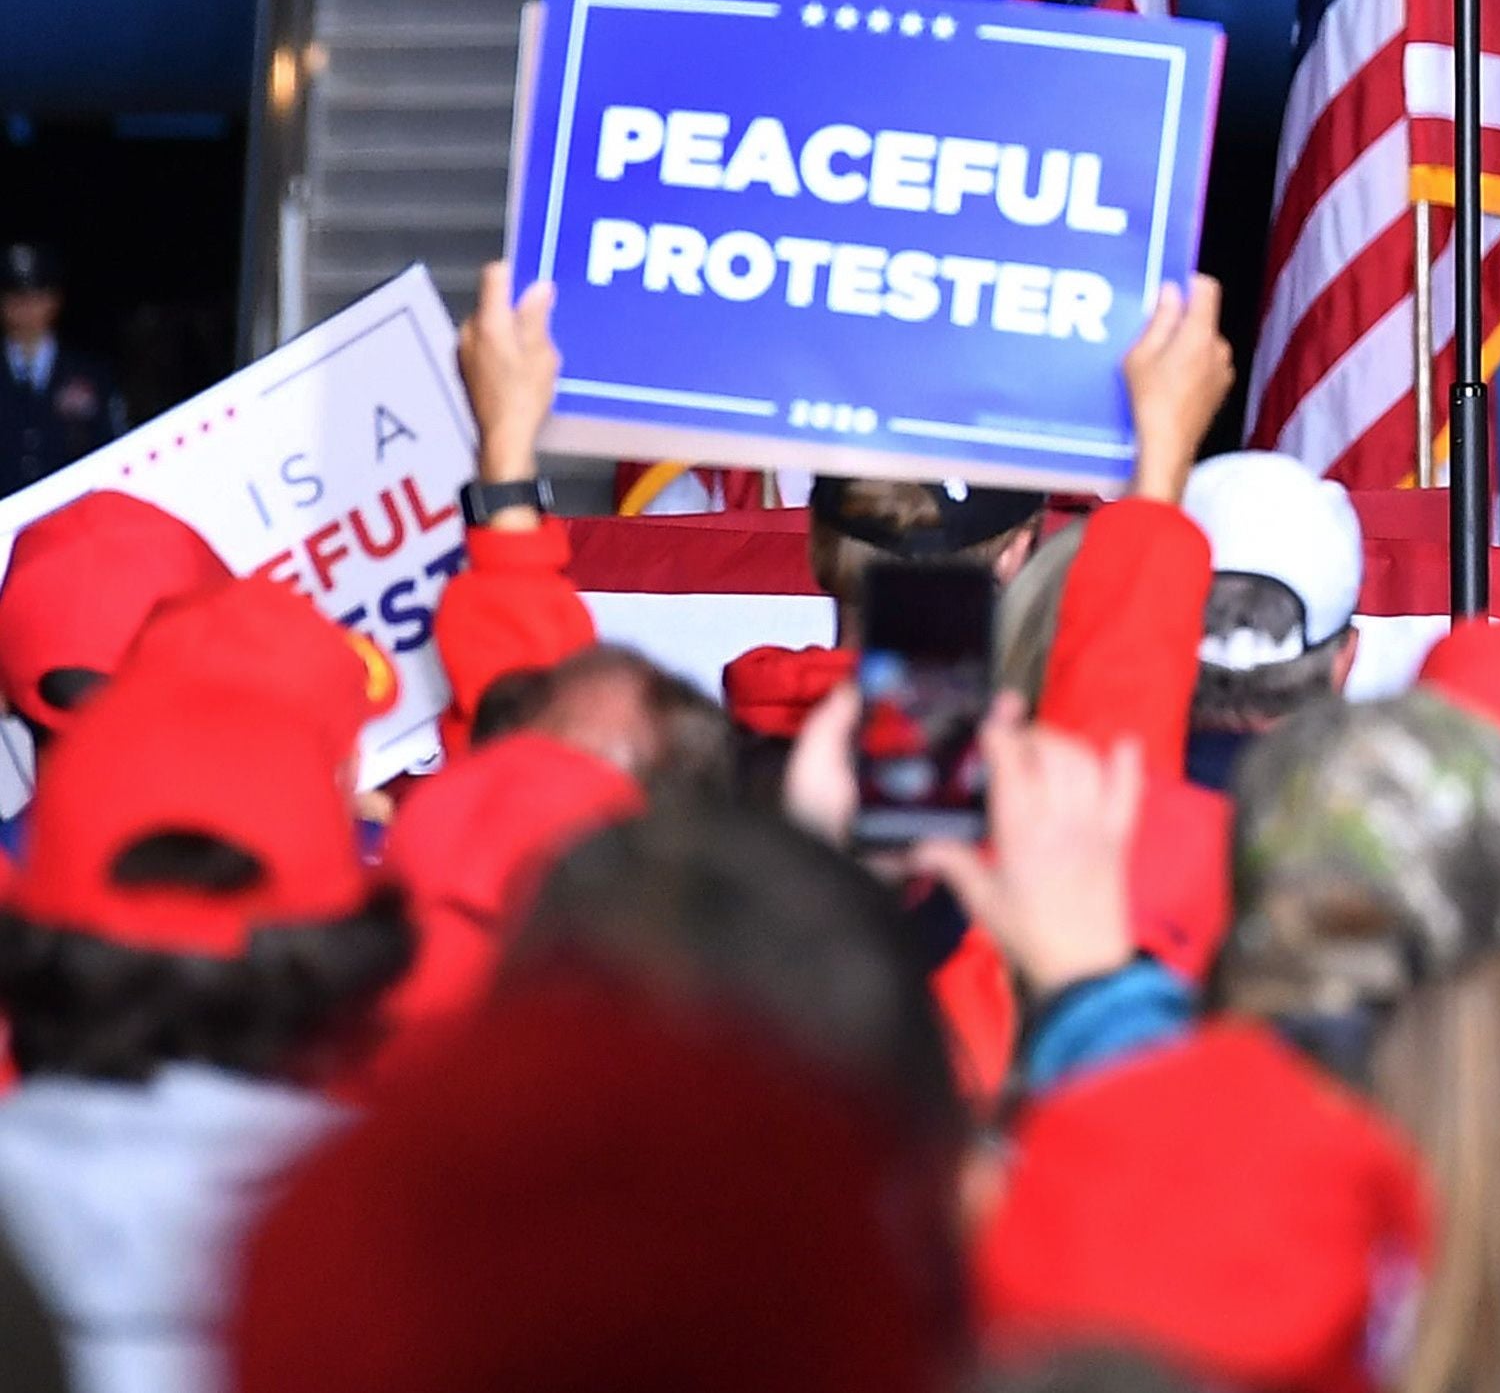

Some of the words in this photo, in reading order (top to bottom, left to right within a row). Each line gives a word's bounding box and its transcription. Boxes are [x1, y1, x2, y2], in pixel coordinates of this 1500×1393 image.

[594, 104, 1129, 237] PEACEFUL
[586, 217, 1114, 343] PROTESTER
[246, 451, 325, 530] IS
[374, 403, 418, 461] A
